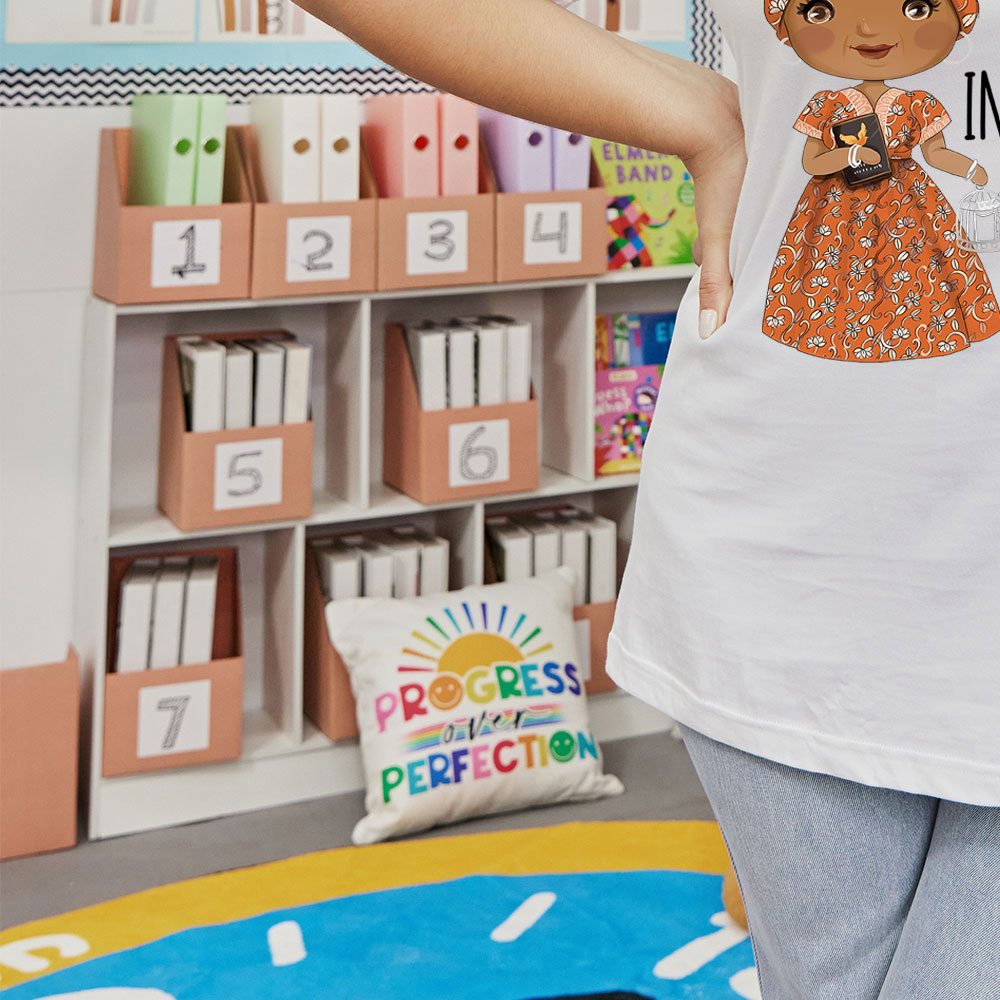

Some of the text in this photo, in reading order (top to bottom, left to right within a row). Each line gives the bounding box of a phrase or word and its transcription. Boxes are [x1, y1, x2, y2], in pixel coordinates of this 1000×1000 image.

[616, 164, 673, 184] BAND
[172, 224, 207, 279] 1
[300, 228, 335, 271] 2
[424, 219, 456, 262] 3
[531, 210, 569, 255] 4
[228, 449, 264, 497] 5
[459, 424, 498, 481] 6
[156, 695, 192, 751] 7
[374, 661, 582, 734] PROGRESS
[381, 730, 598, 804] PERFECTION
